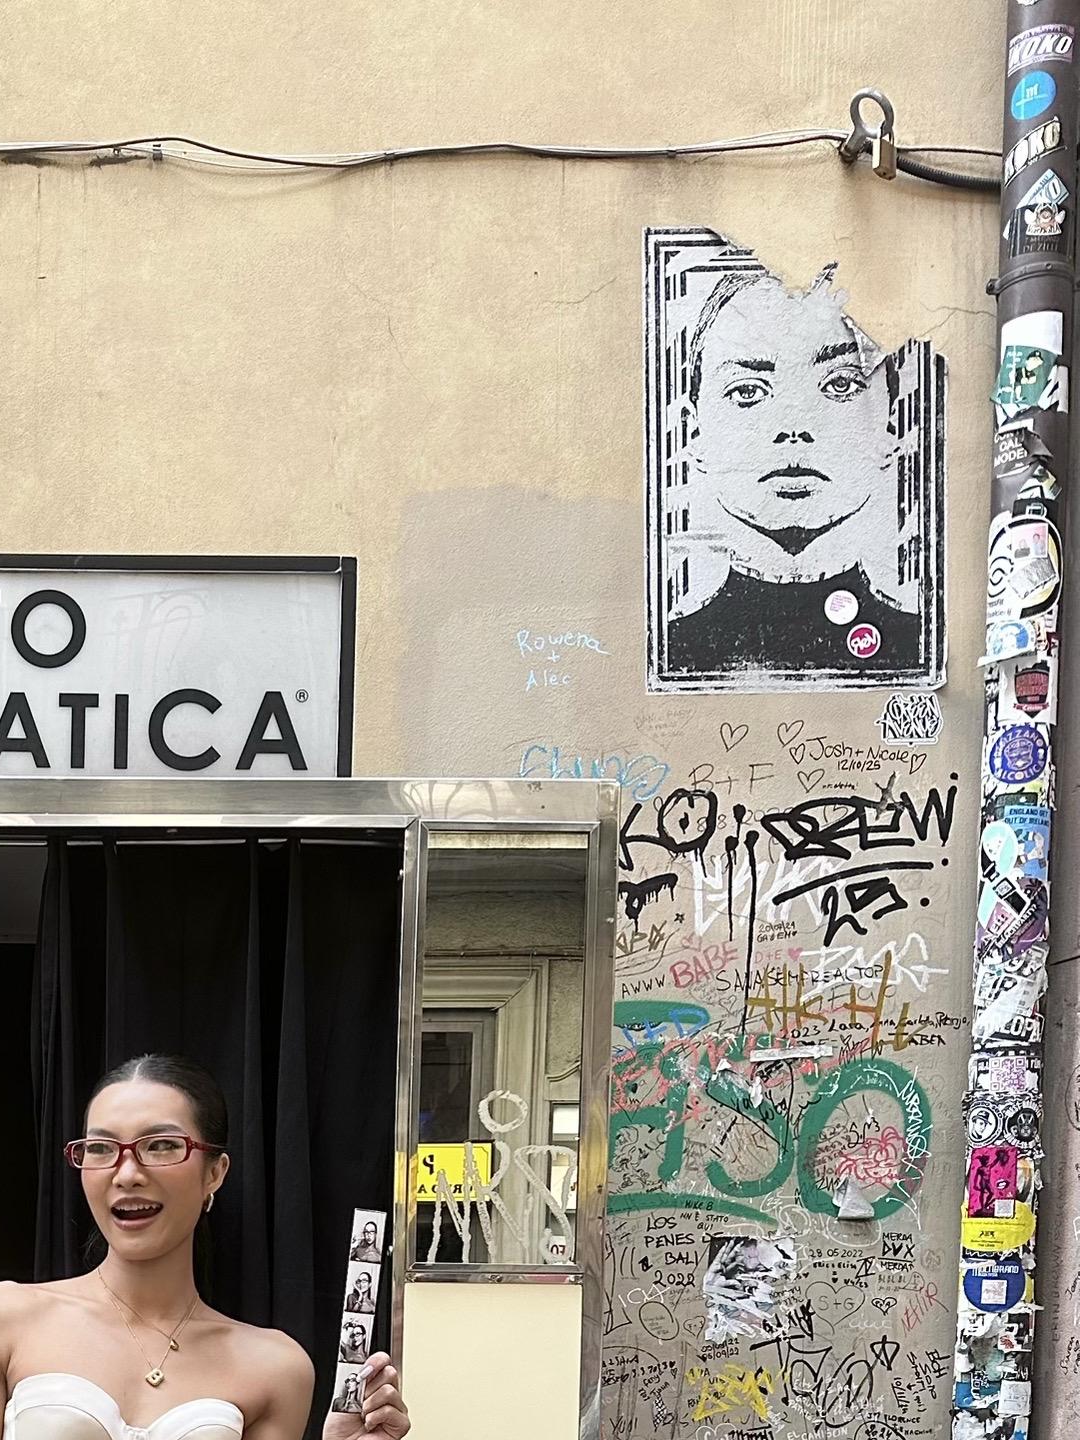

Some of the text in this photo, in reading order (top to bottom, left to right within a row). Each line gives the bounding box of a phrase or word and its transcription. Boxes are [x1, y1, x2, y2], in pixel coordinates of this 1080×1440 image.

[806, 736, 853, 761] Josh
[670, 943, 740, 989] BABE
[646, 1215, 677, 1232] LOS
[644, 1234, 695, 1249] PENES
[654, 1271, 696, 1288] 2022
